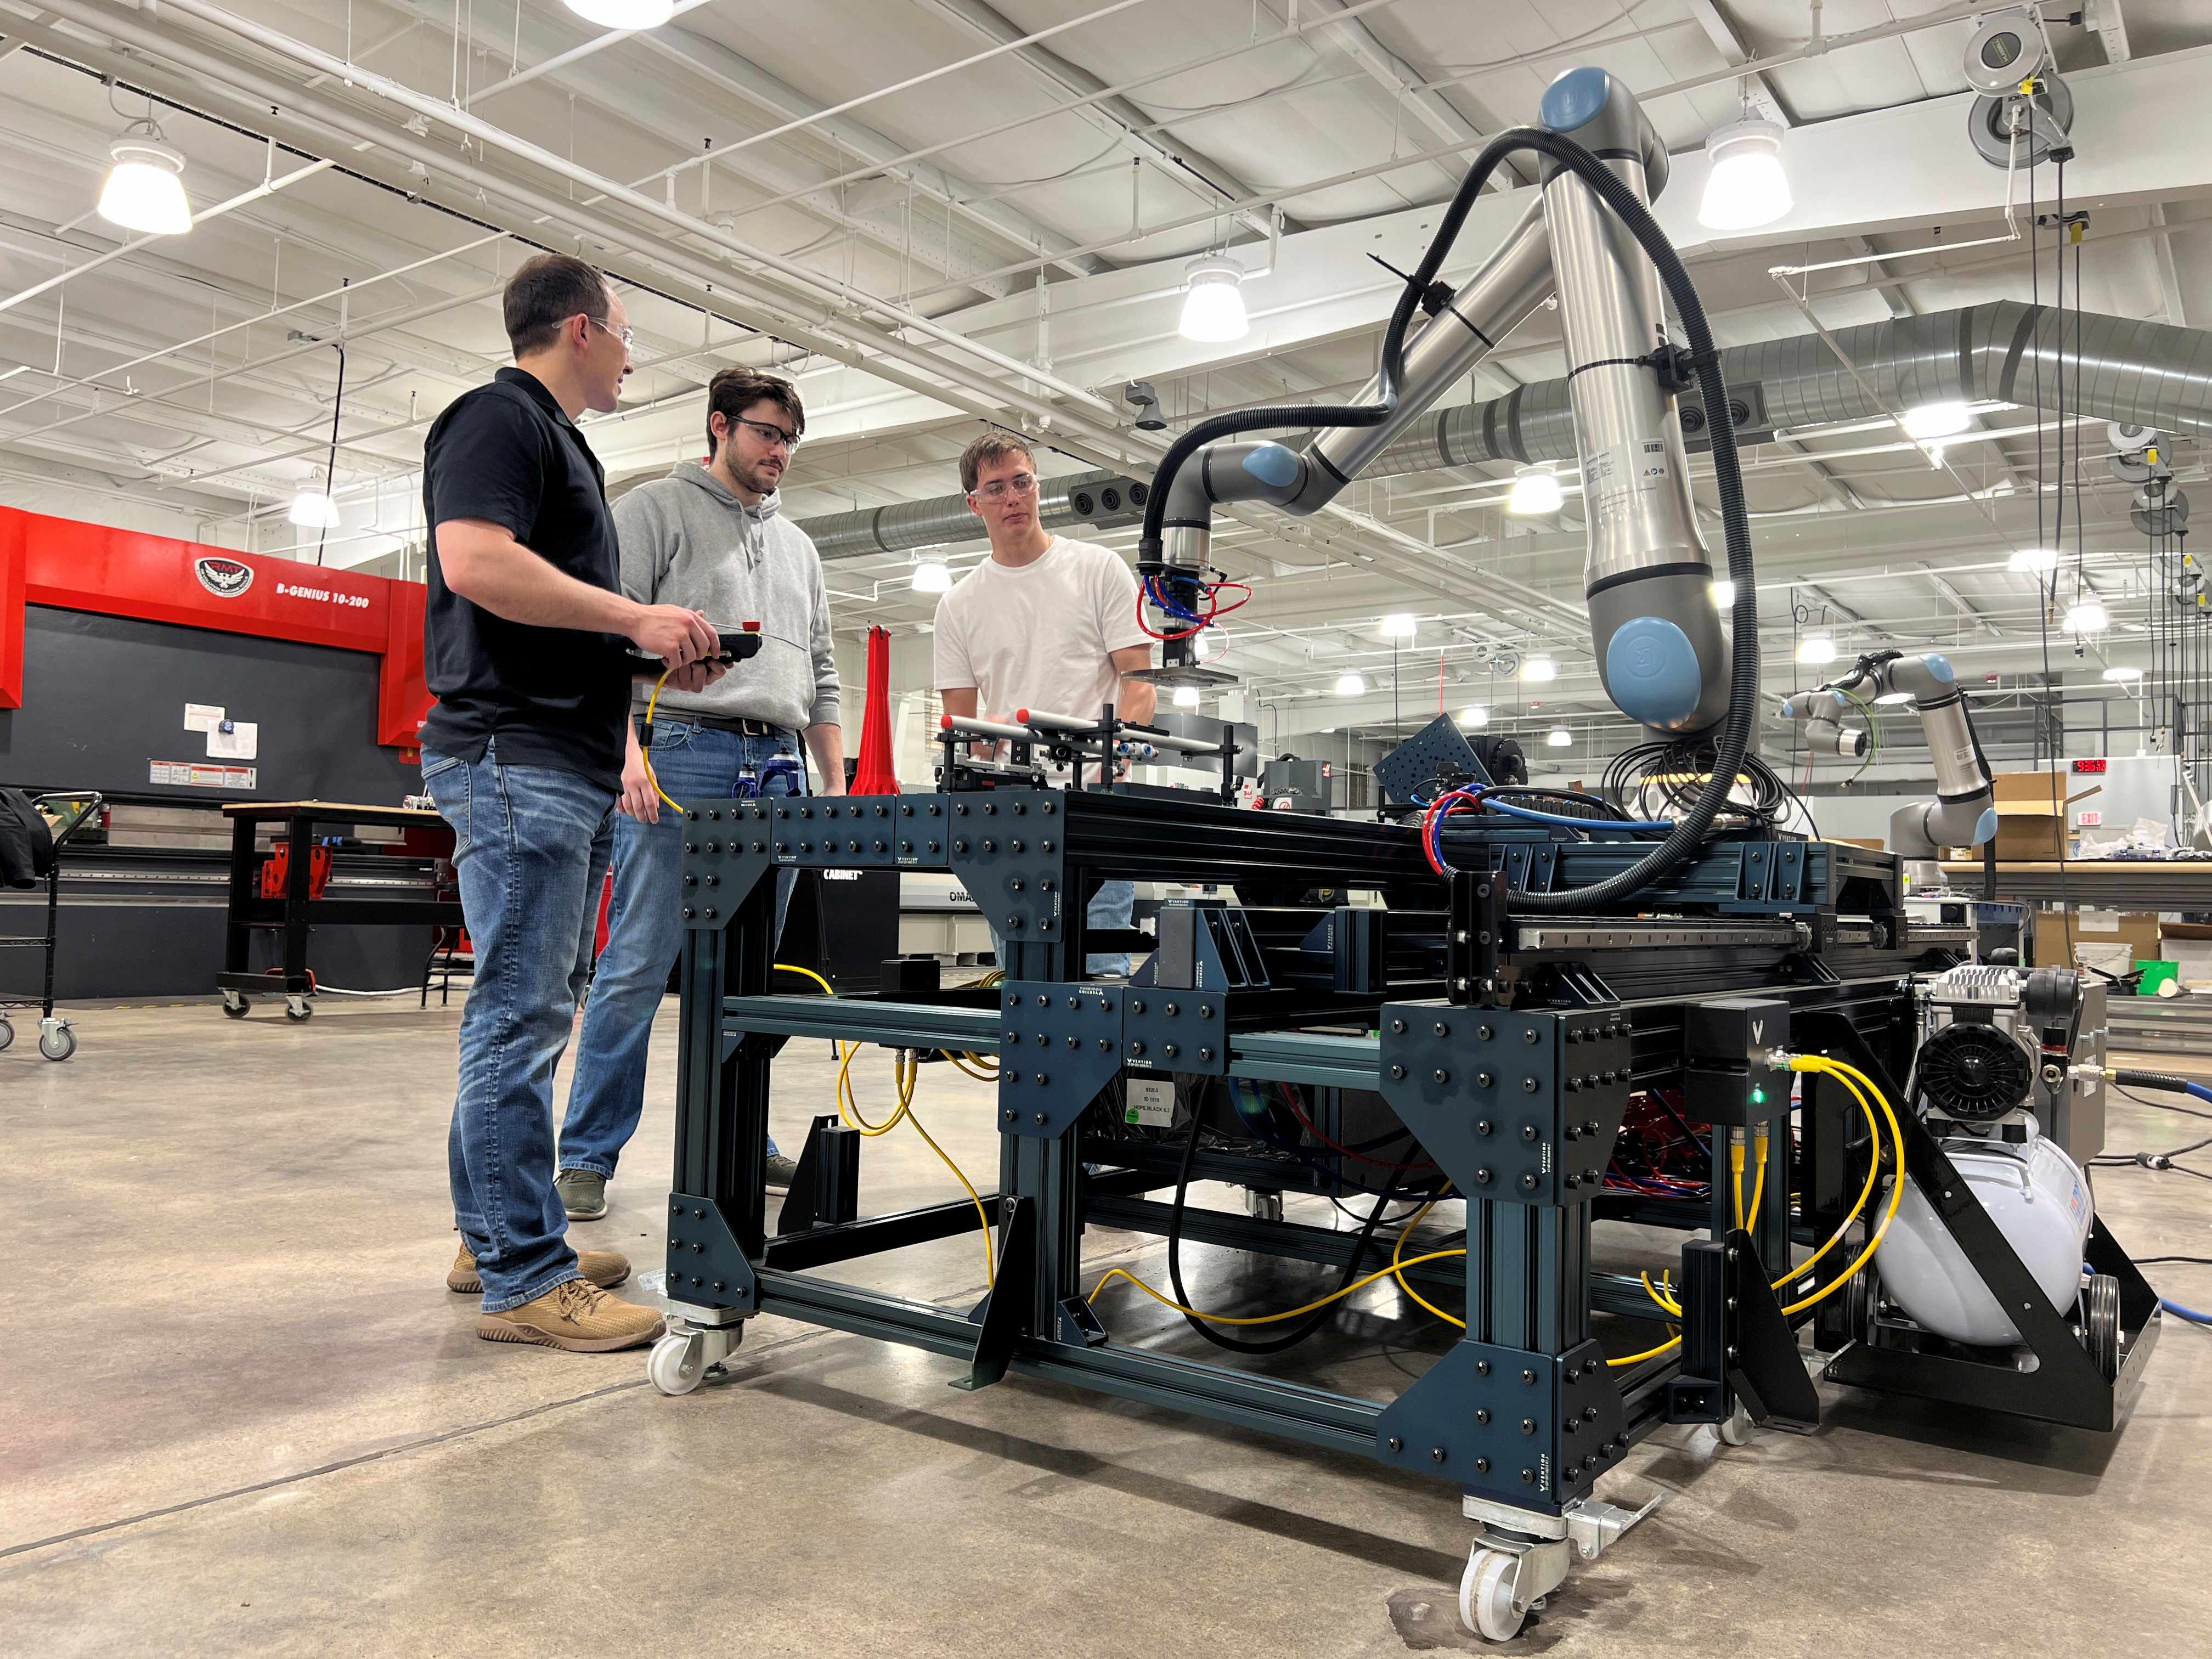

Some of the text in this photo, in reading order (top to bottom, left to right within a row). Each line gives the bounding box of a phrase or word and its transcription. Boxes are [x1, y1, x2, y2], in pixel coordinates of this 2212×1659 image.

[208, 560, 242, 574] RMT
[276, 583, 370, 609] B-GENIUS 10-200
[2081, 813, 2098, 825] EXIT
[823, 869, 858, 881] CABINET
[950, 891, 975, 902] OMA
